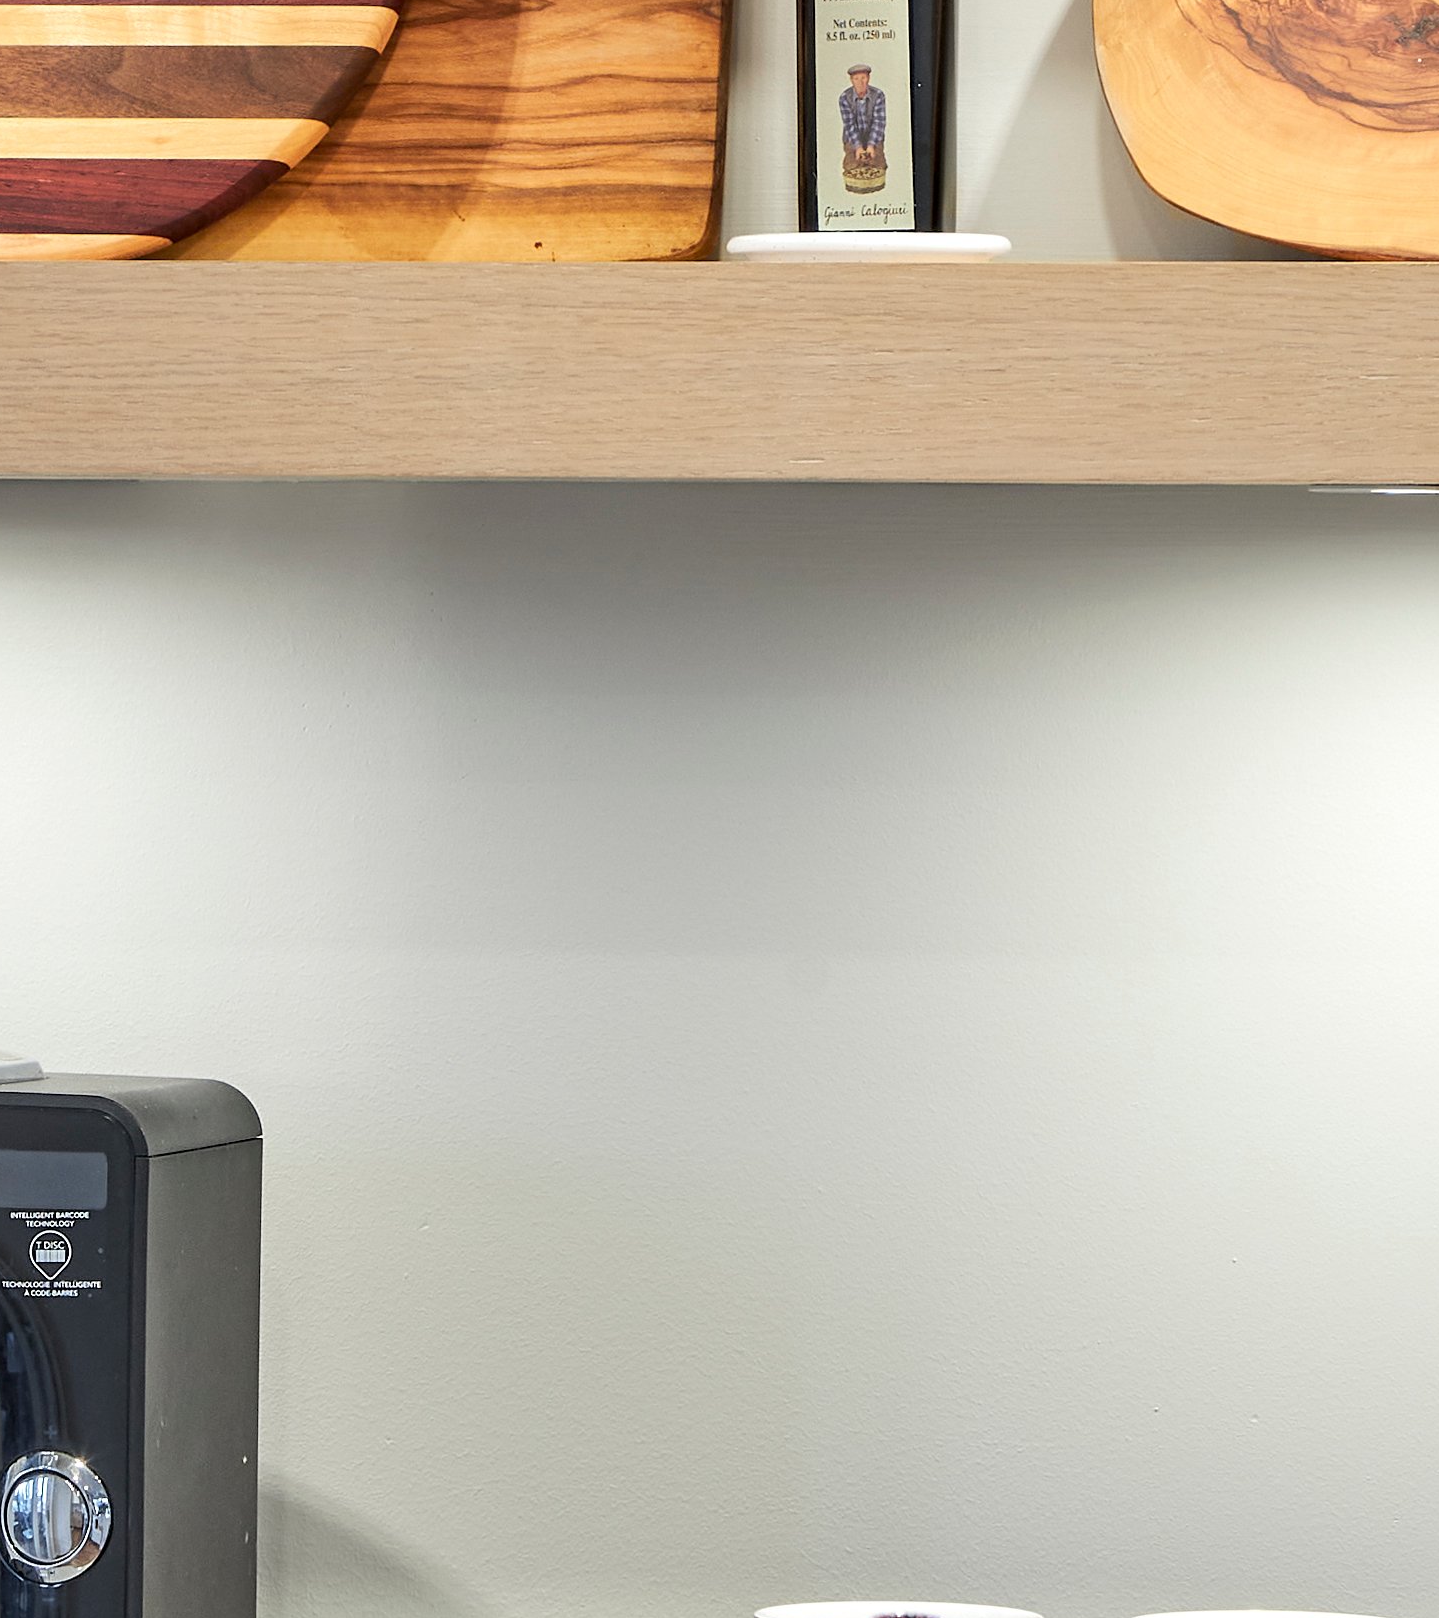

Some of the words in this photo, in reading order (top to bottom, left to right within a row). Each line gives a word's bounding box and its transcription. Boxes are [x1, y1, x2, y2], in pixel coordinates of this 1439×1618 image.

[834, 19, 846, 29] Net
[849, 18, 887, 28] Contents:
[827, 31, 837, 42] 8.5
[850, 32, 860, 41] oz.
[863, 29, 879, 41] (250
[882, 29, 895, 41] ml)
[11, 1211, 54, 1220] INTELLIGENT
[56, 1211, 89, 1220] BARCODE
[26, 1220, 74, 1228] TECHNOLOGY
[36, 1241, 42, 1250] T
[2, 1280, 50, 1289] TECHNOLOGIE
[54, 1280, 101, 1289] INTELLIGENTE
[24, 1288, 30, 1297] À
[31, 1289, 78, 1297] CODE-BARRES
